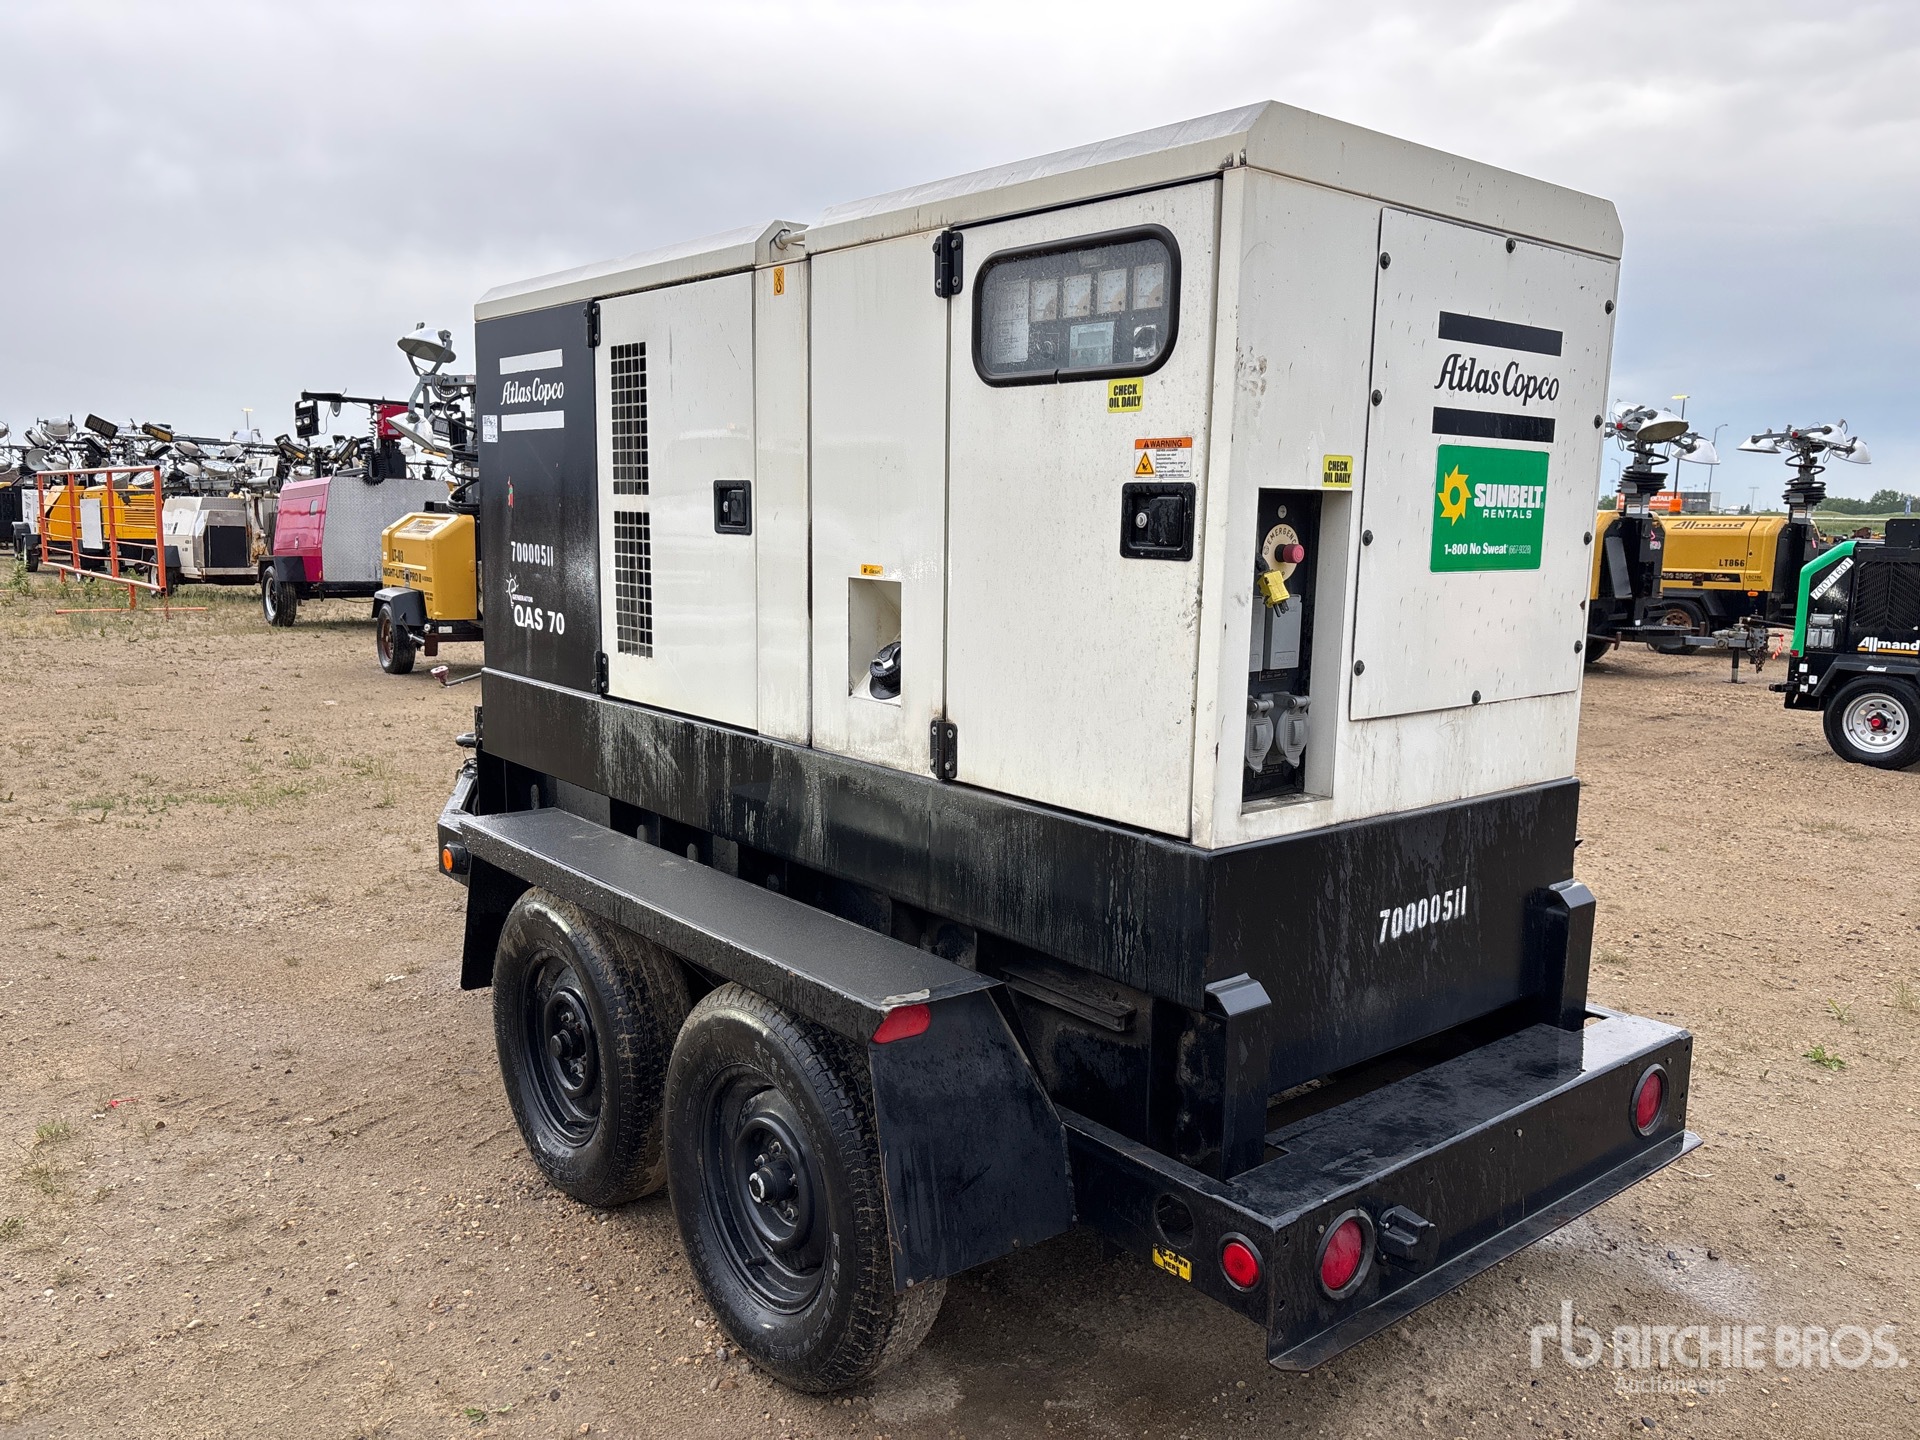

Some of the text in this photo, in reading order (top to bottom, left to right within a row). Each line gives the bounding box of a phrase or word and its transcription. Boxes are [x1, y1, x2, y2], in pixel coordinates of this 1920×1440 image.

[1434, 353, 1560, 406] Atlas Copco
[500, 377, 564, 406] Atlas Copco
[1113, 384, 1138, 396] CHECK
[1109, 395, 1141, 408] OIL DAILY
[1149, 439, 1182, 448] WARNING
[1328, 460, 1348, 471] CHECK
[1324, 472, 1351, 483] OIL DAILY
[1473, 483, 1544, 508] SUNBELT
[1482, 509, 1532, 519] RENTALS
[1673, 520, 1745, 529] Allmand
[1267, 527, 1297, 545] EMERGENC
[510, 541, 553, 567] 70000511
[1444, 543, 1468, 555] 1-800
[1469, 543, 1481, 554] No
[1482, 542, 1506, 555] Sweat
[514, 604, 565, 635] QAS 70
[1857, 637, 1920, 652] Allmand
[1379, 885, 1467, 943] 70000511
